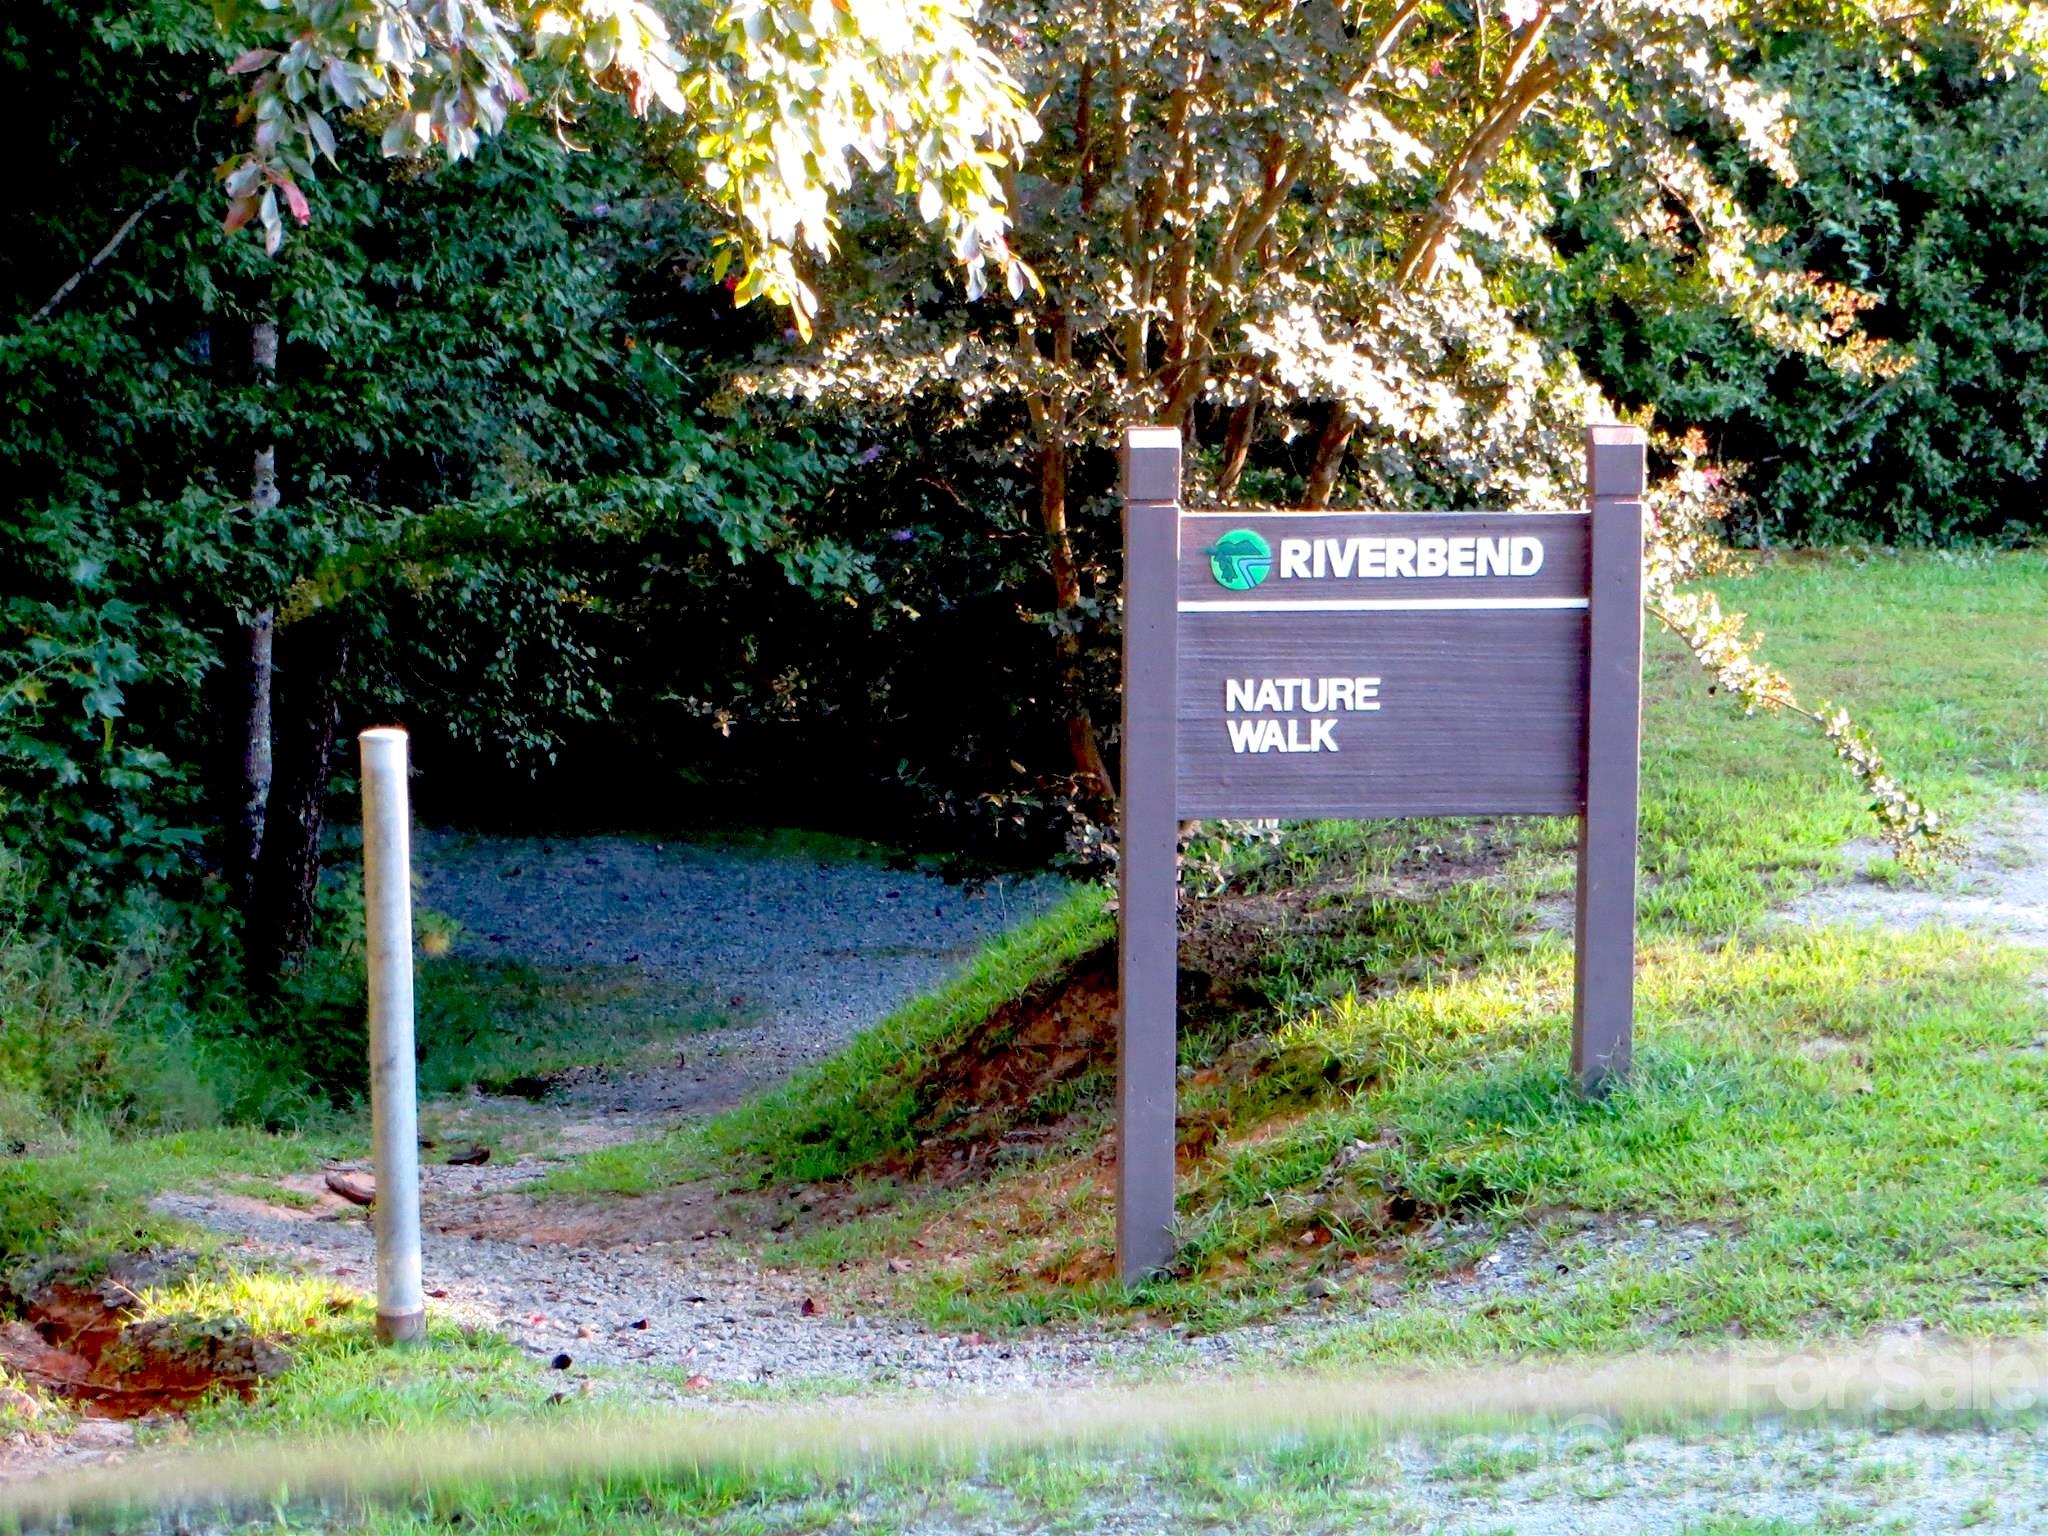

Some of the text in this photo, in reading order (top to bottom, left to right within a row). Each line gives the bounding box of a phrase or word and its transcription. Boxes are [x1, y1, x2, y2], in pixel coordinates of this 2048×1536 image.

[1280, 537, 1543, 579] RIVERBEND
[1226, 678, 1381, 712] NATURE
[1226, 719, 1339, 753] WALK
